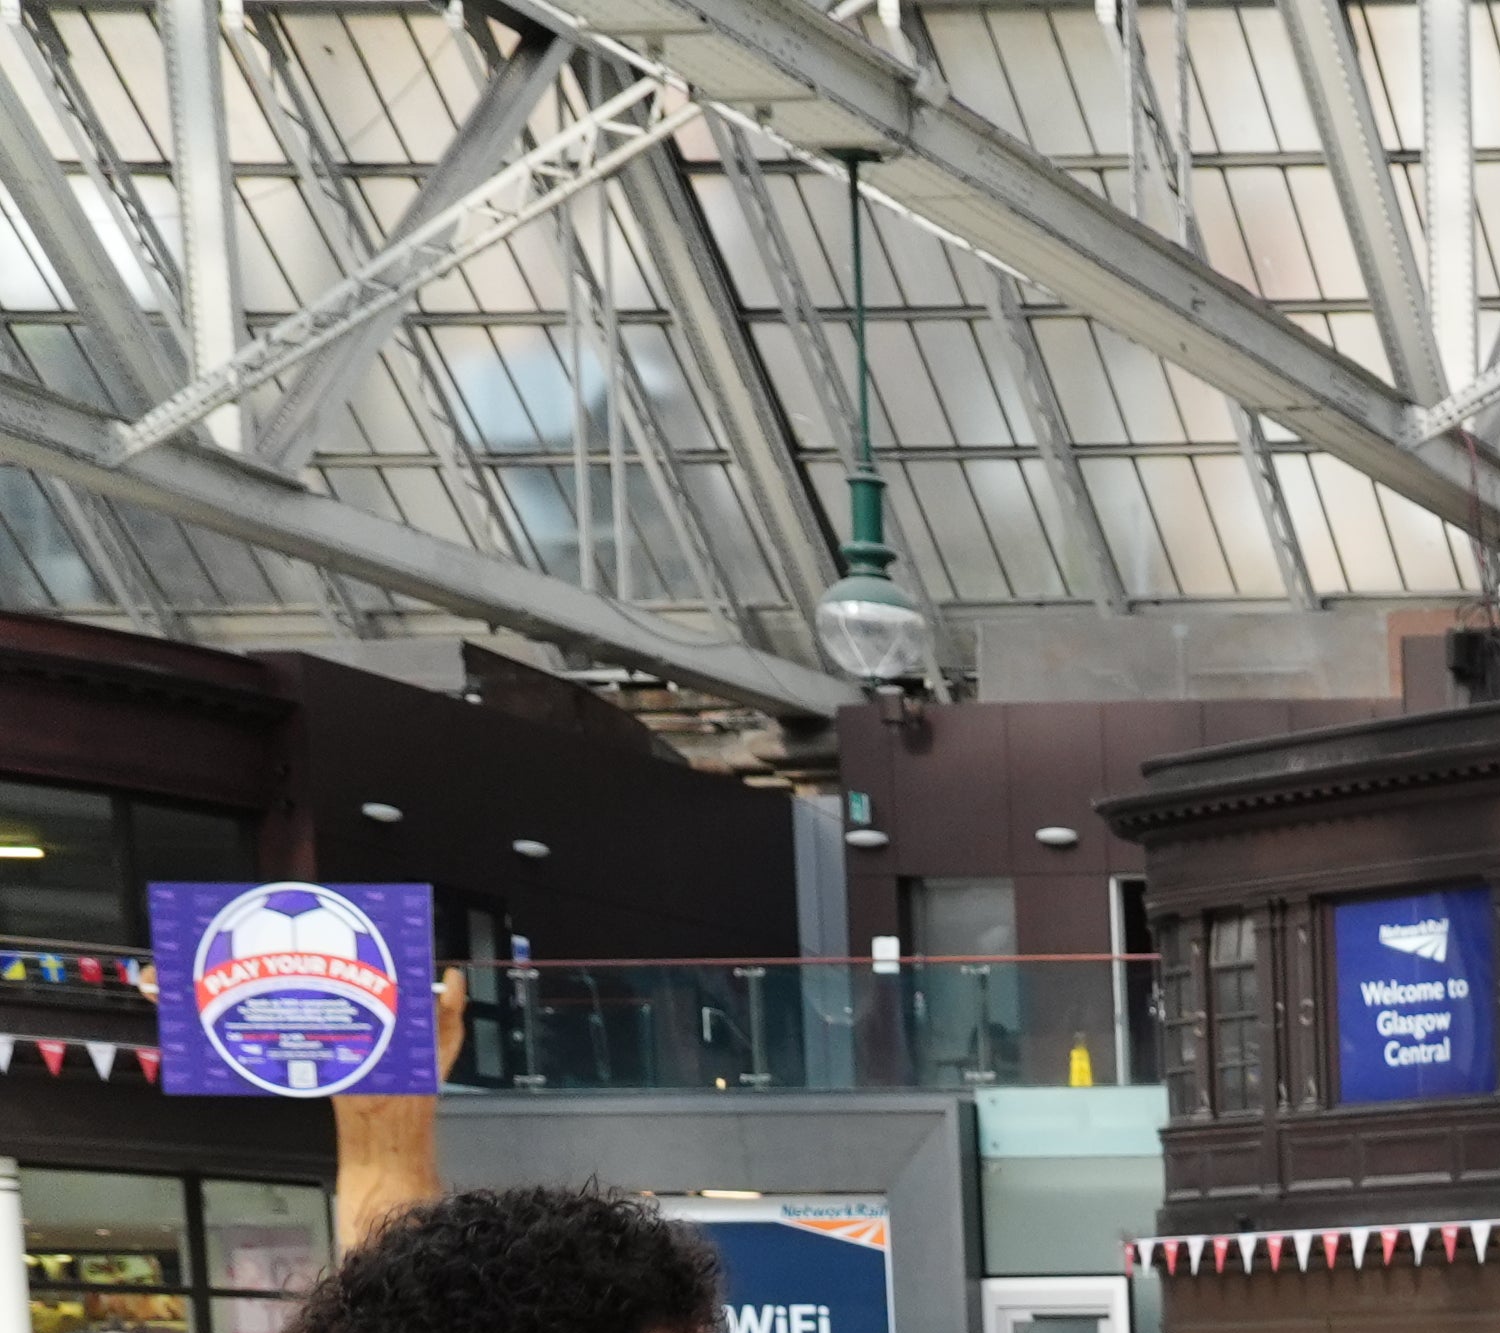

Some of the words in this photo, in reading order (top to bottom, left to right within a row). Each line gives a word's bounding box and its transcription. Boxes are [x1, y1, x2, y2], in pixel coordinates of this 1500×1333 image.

[203, 959, 261, 995] PLAY
[263, 955, 328, 974] YOUR
[330, 957, 389, 994] PART
[1360, 979, 1445, 1006] Welcome
[1447, 977, 1469, 999] to
[1376, 1010, 1451, 1040] Glasgow
[1384, 1036, 1451, 1067] Central
